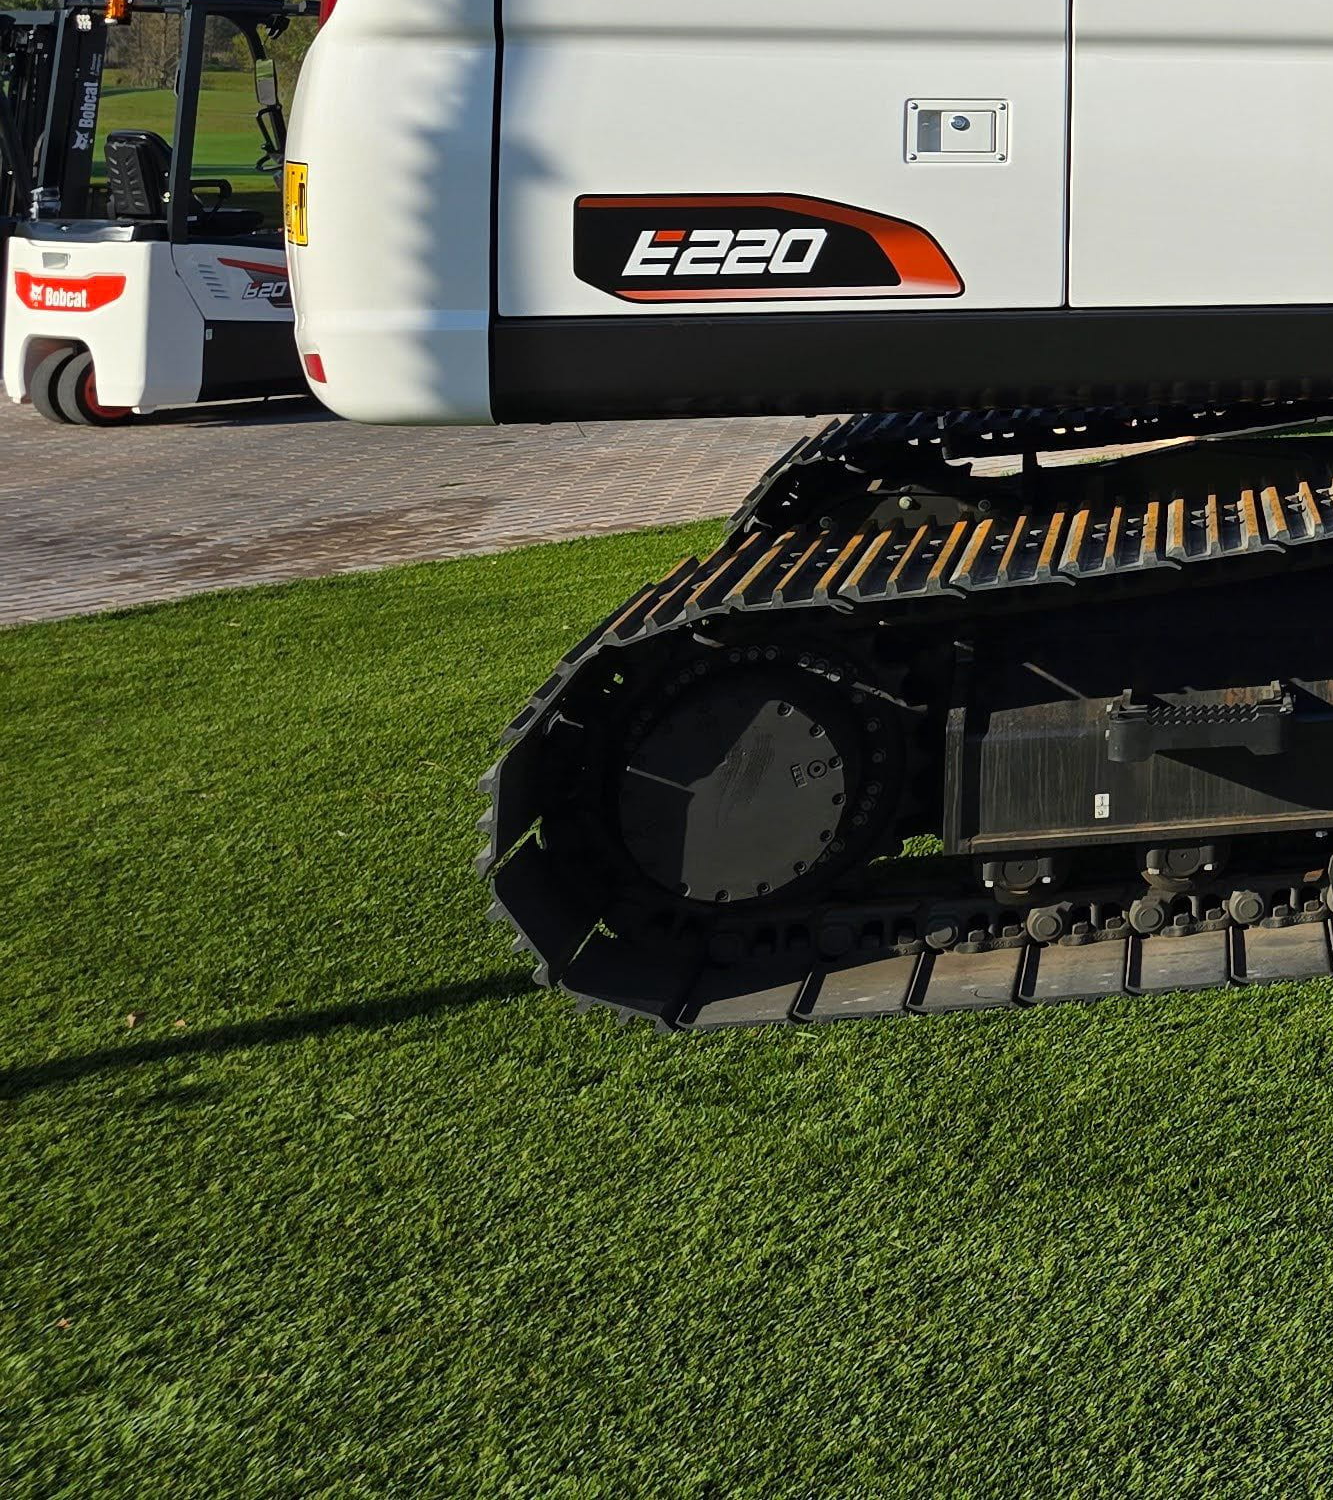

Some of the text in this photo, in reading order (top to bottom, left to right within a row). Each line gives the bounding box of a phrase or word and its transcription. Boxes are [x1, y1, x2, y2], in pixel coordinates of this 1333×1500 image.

[79, 82, 98, 128] Bobcat
[621, 228, 828, 276] E220
[46, 287, 87, 308] Bobcat
